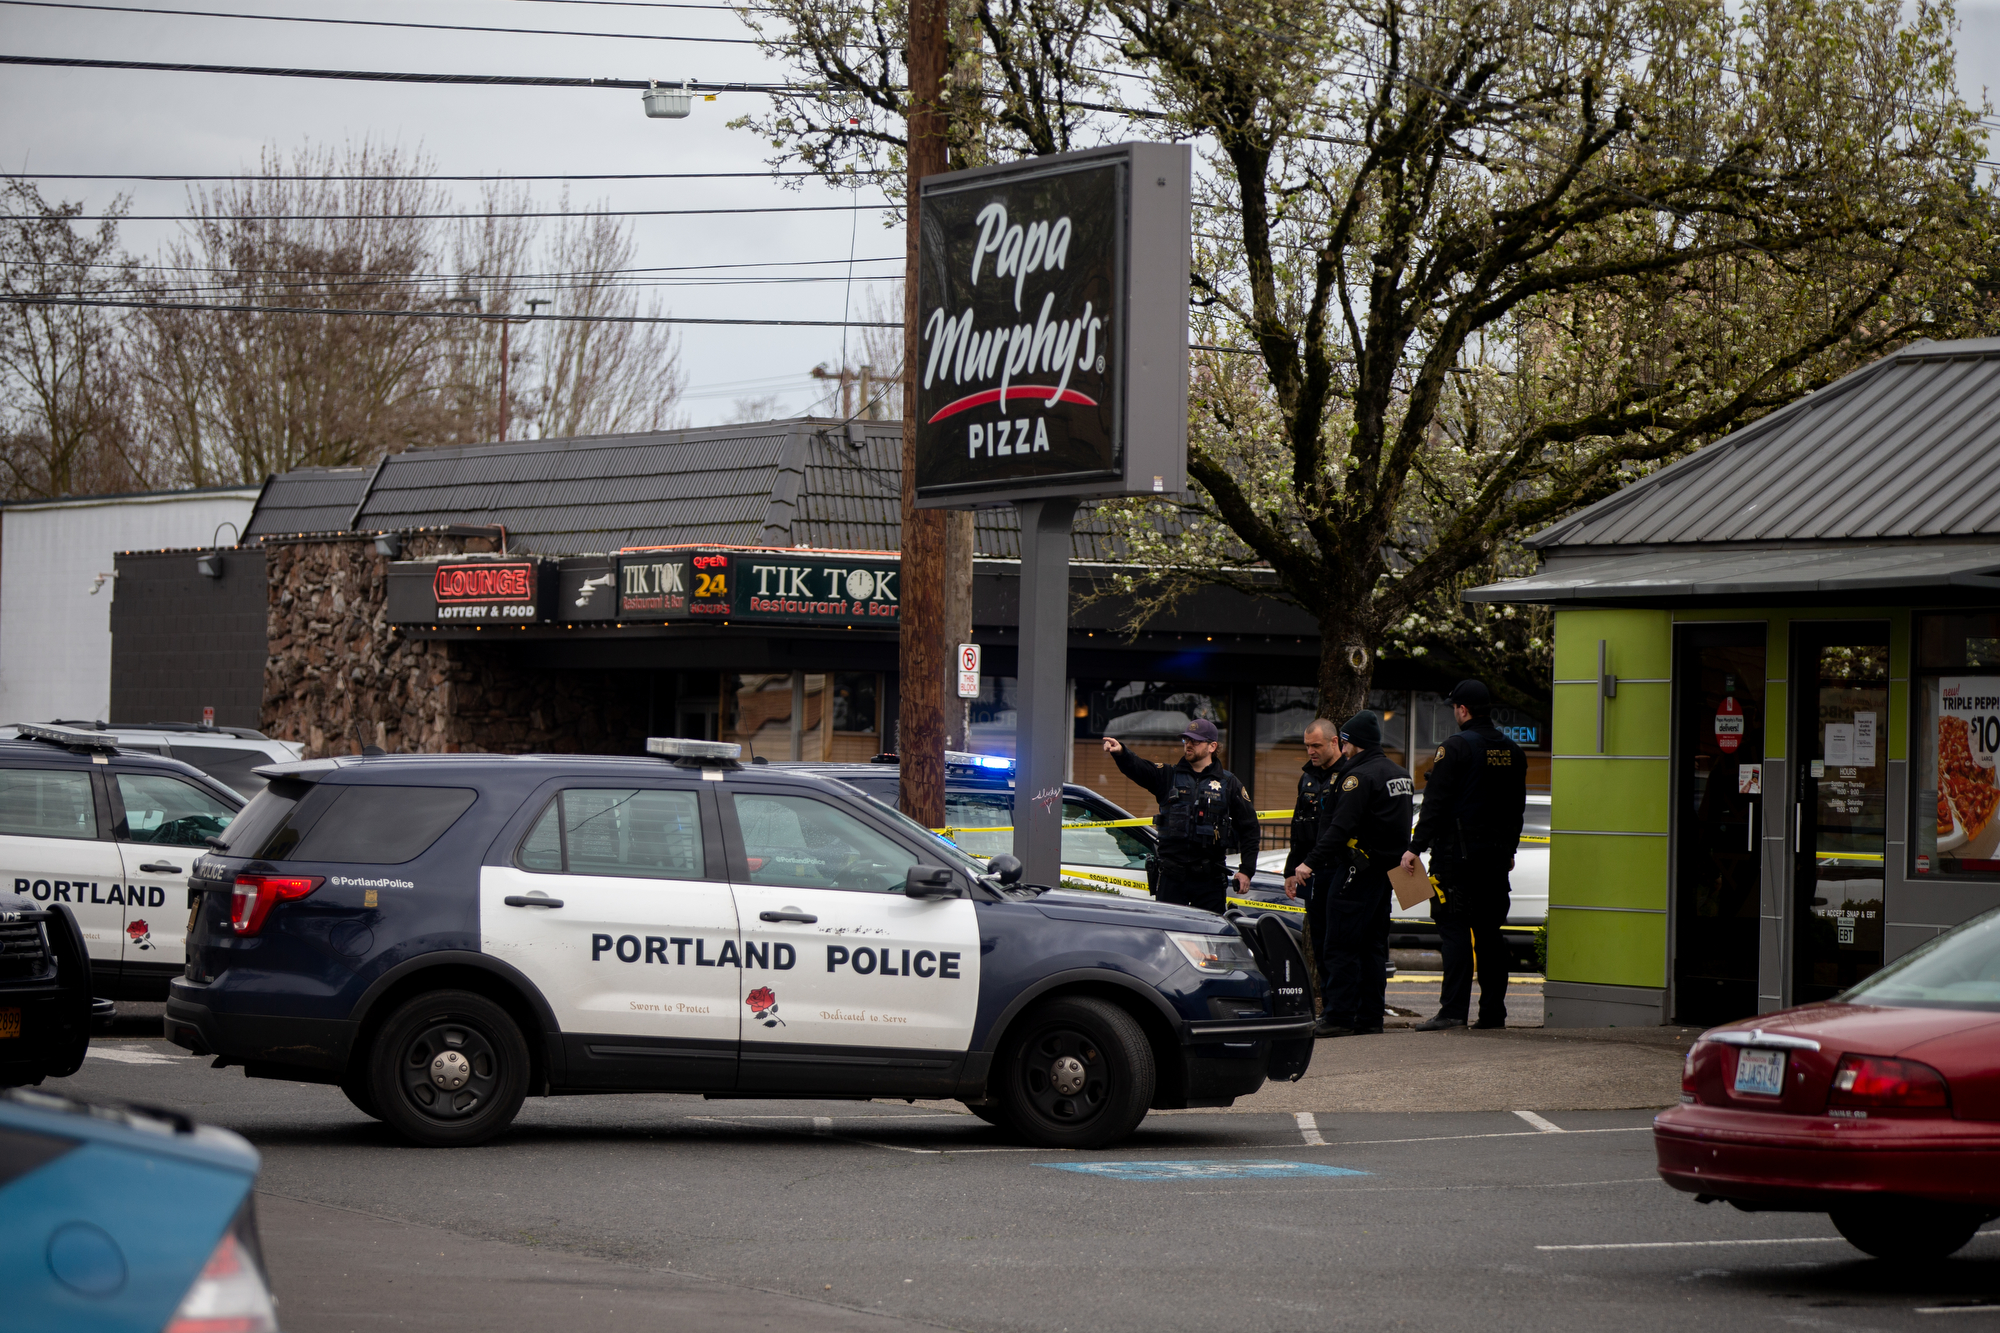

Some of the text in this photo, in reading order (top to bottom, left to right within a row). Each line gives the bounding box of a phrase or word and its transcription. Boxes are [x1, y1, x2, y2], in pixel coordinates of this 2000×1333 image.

[971, 202, 1072, 313] Papa
[923, 291, 1102, 415] Murphy's
[969, 416, 1050, 459] PIZZA
[692, 555, 728, 570] OPEN
[439, 569, 527, 597] LOUNGE
[622, 563, 684, 595] TIK TOK
[694, 573, 728, 598] 24
[752, 565, 898, 601] TIK TOK
[622, 594, 685, 611] Restaurant & Bar
[690, 603, 731, 615] HOURS
[750, 596, 899, 617] Restaurant & Bar
[437, 605, 535, 619] LOTTERY & FOOD
[963, 674, 975, 683] THIS
[960, 683, 977, 692] BLOCK
[1943, 683, 1960, 697] new!
[1943, 696, 2000, 710] TRIPLE PEPP!
[1486, 749, 1511, 757] PORTLAND
[1487, 757, 1512, 766] POLICE
[1839, 767, 1857, 776] HOURS
[199, 862, 227, 880] POLICE
[1089, 873, 1108, 883] CROSS
[331, 875, 415, 889] @PortlandPolice
[14, 878, 166, 907] PORTLAND
[1817, 909, 1825, 917] WE
[1826, 909, 1846, 918] ACCEPT
[1846, 910, 1860, 918] SNAP
[1866, 911, 1876, 919] EBT
[82, 932, 101, 940] rotect
[1839, 929, 1853, 942] EBT
[591, 933, 961, 980] PORTLAND POLICE
[1277, 987, 1304, 995] 170019
[629, 1000, 711, 1014] Sworn to Protect
[819, 1008, 907, 1024] Dedicated to Serve
